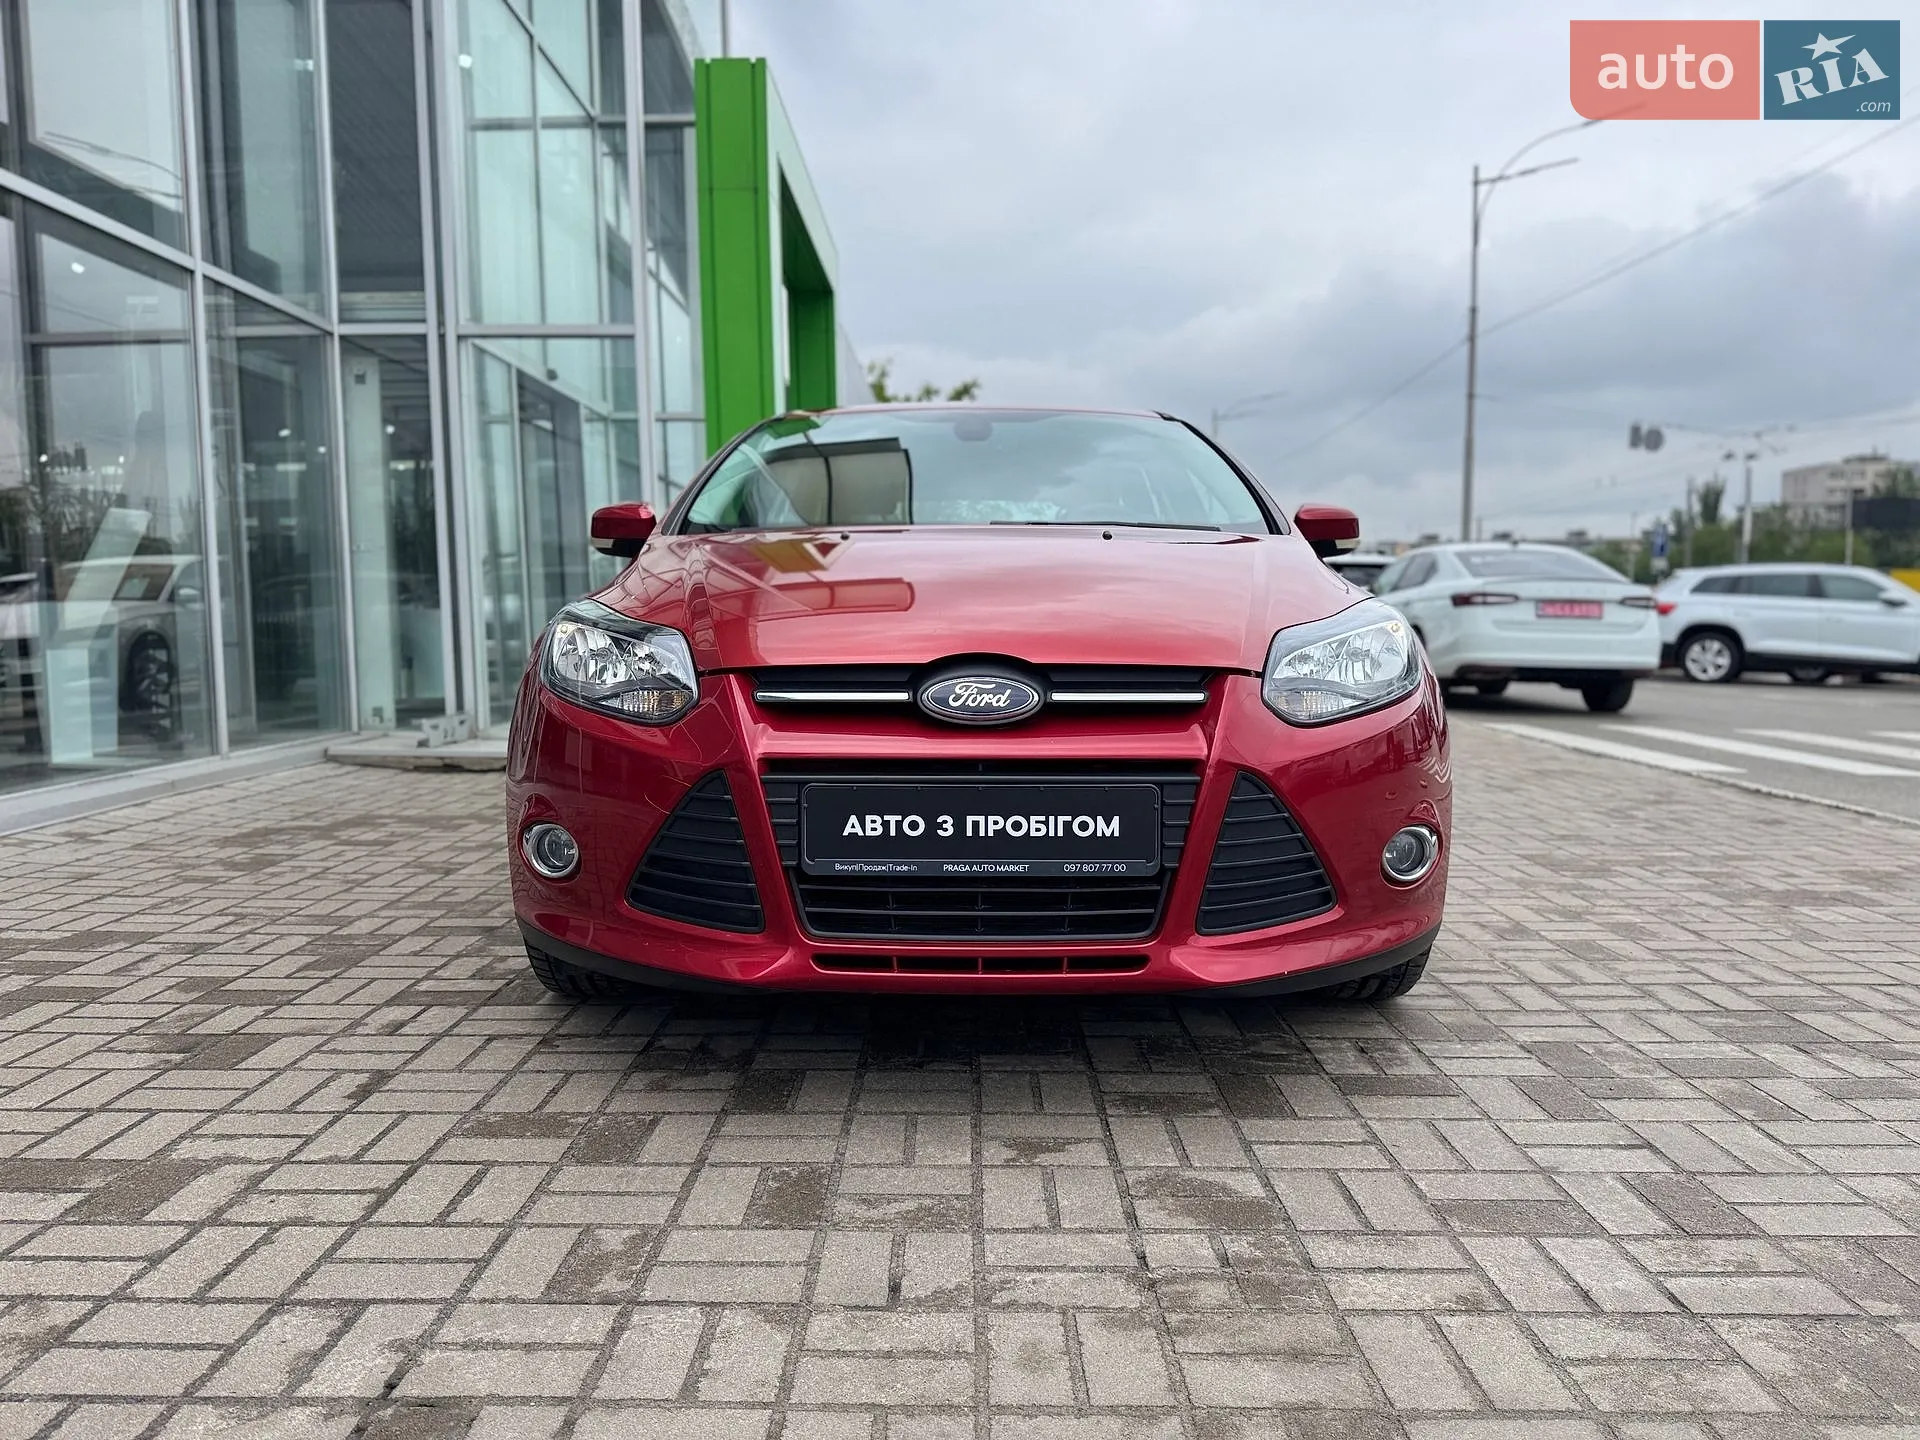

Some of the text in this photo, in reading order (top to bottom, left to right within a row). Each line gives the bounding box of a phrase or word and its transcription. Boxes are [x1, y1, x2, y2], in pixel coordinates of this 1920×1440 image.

[948, 682, 1011, 707] Ford
[842, 815, 926, 837] АВТО
[966, 815, 1120, 837] ПРОБІГОМ
[943, 864, 1029, 872] PRAGA AUTO MARKET
[1063, 863, 1127, 872] 097 807 77 00
